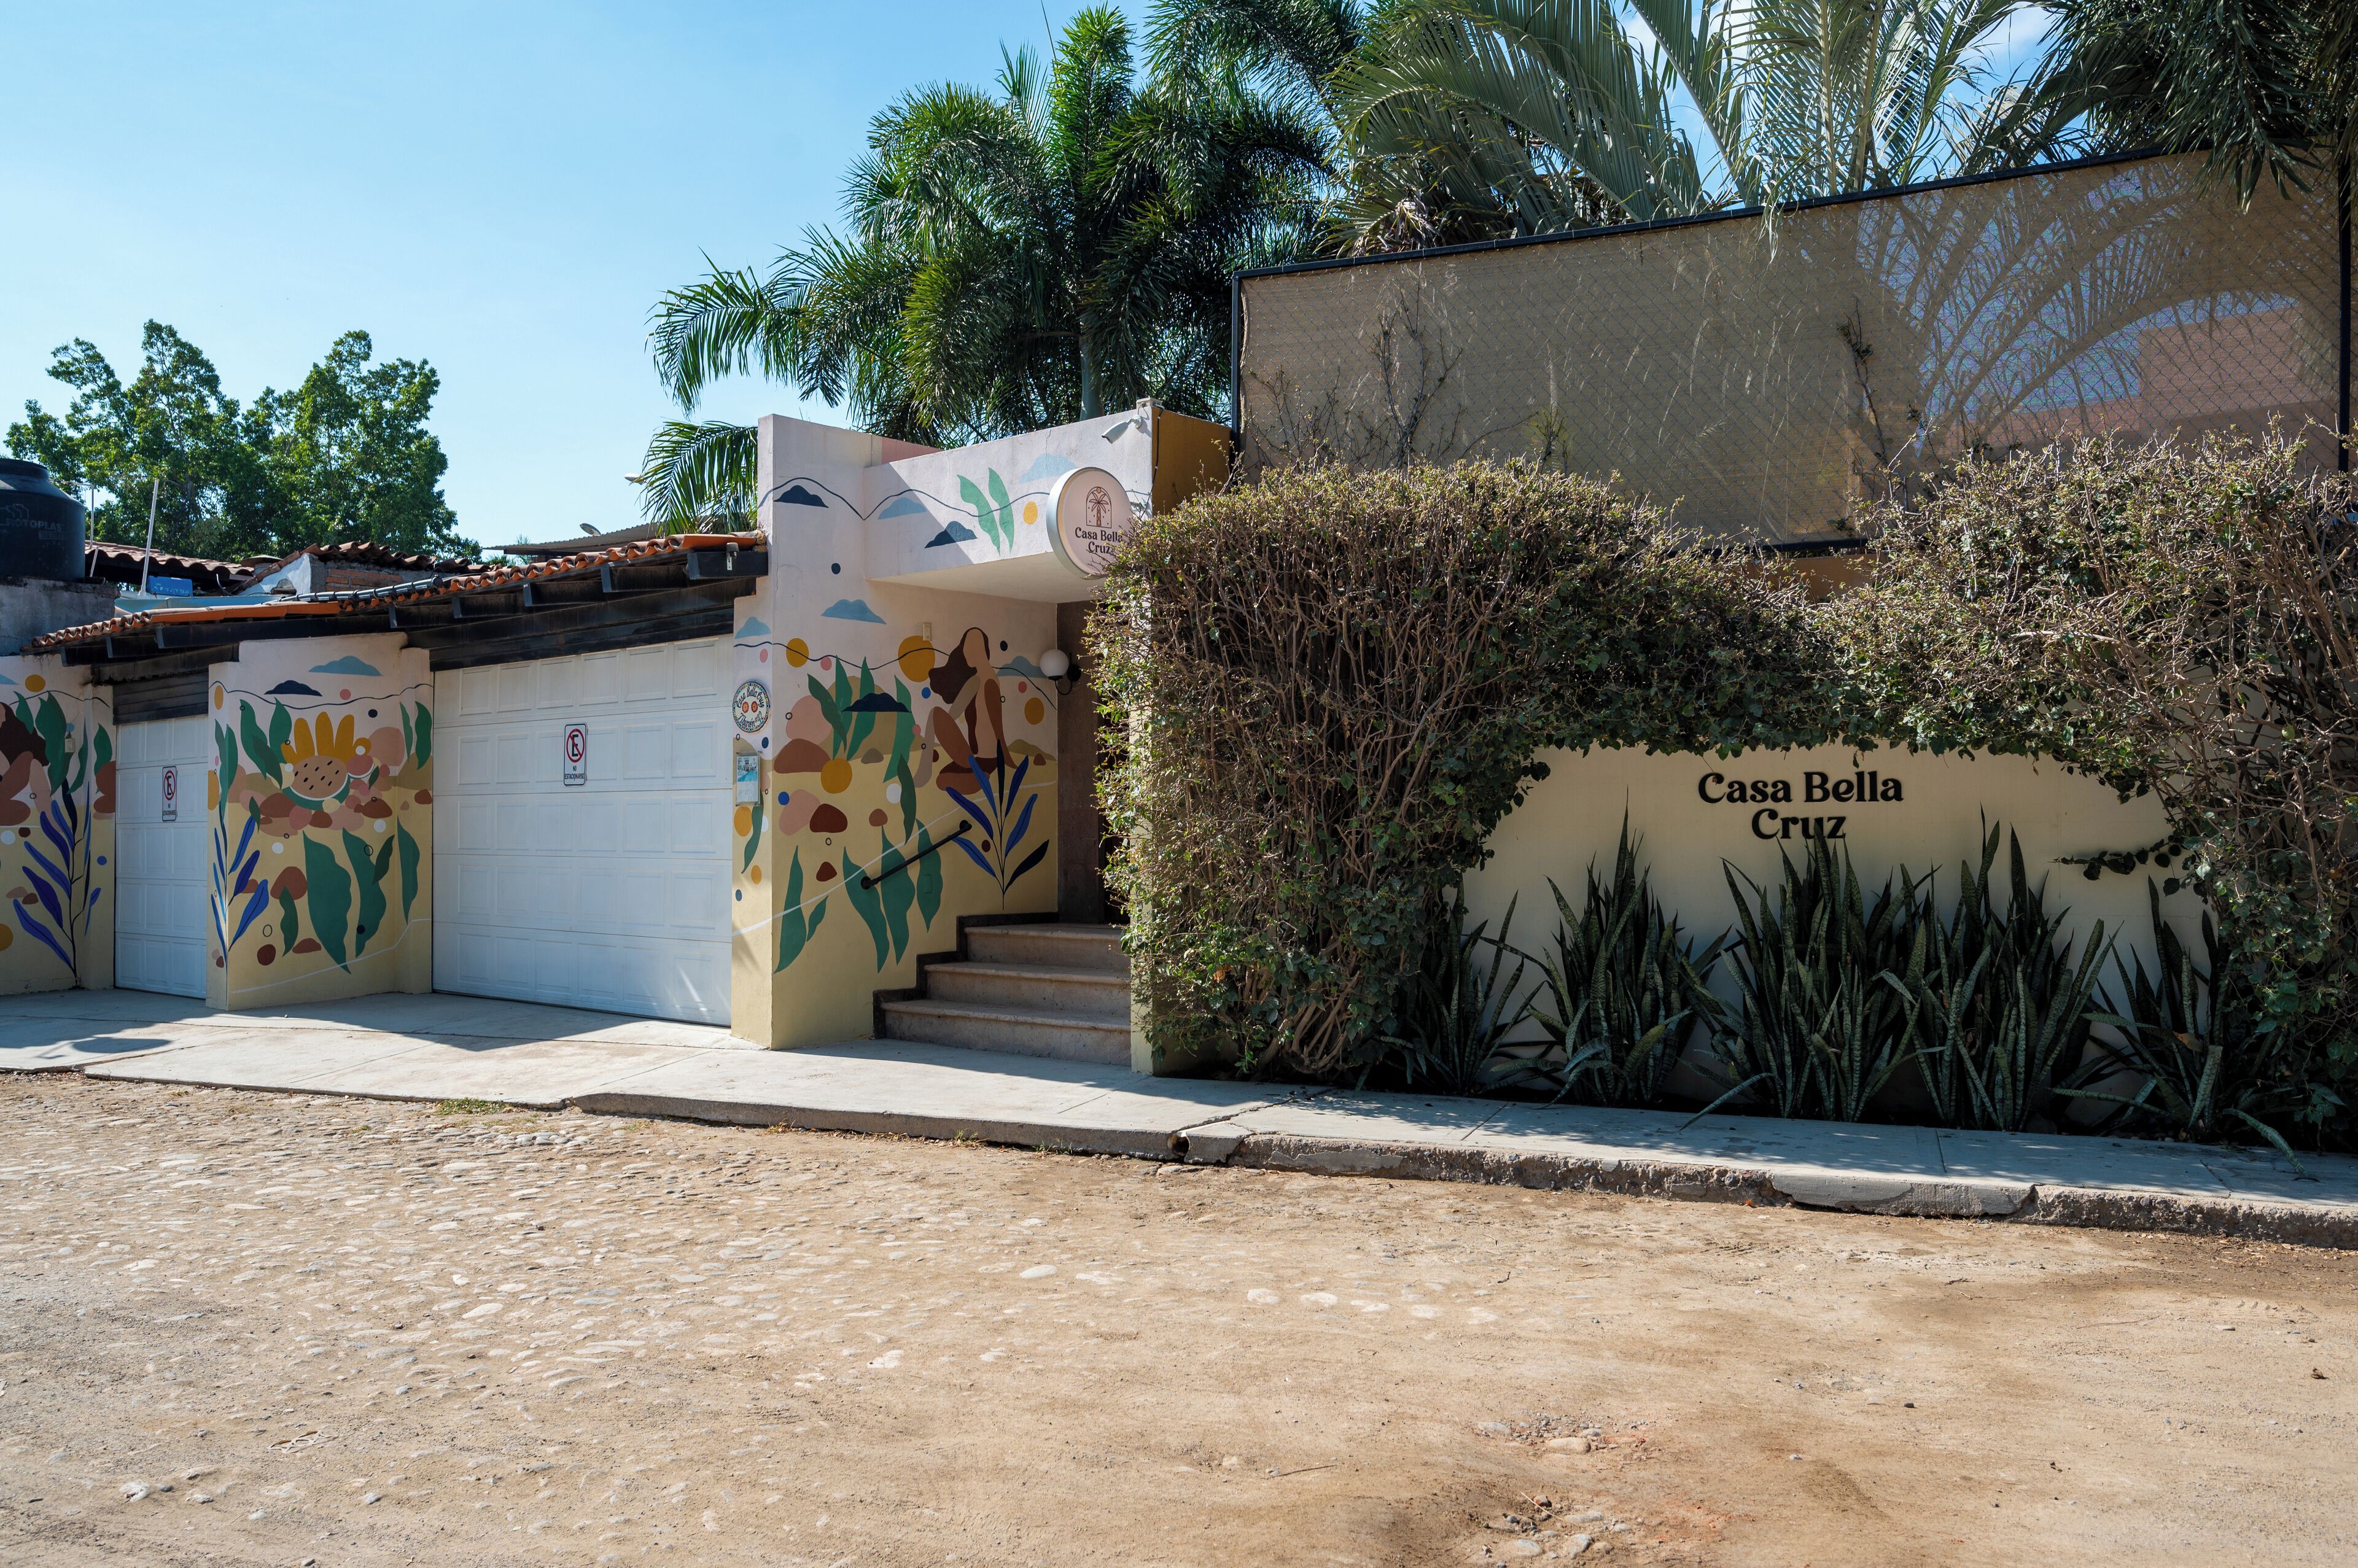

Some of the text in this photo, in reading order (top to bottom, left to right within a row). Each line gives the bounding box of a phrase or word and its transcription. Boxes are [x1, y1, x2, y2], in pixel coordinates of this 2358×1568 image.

[6, 518, 62, 531] ROTOPLAS
[1075, 527, 1123, 543] Casa Bella
[1088, 541, 1112, 554] Cruz
[736, 692, 745, 708] Casa
[746, 686, 757, 697] Bella
[1698, 770, 1904, 804] Casa Bella
[1751, 808, 1846, 840] Cruz
